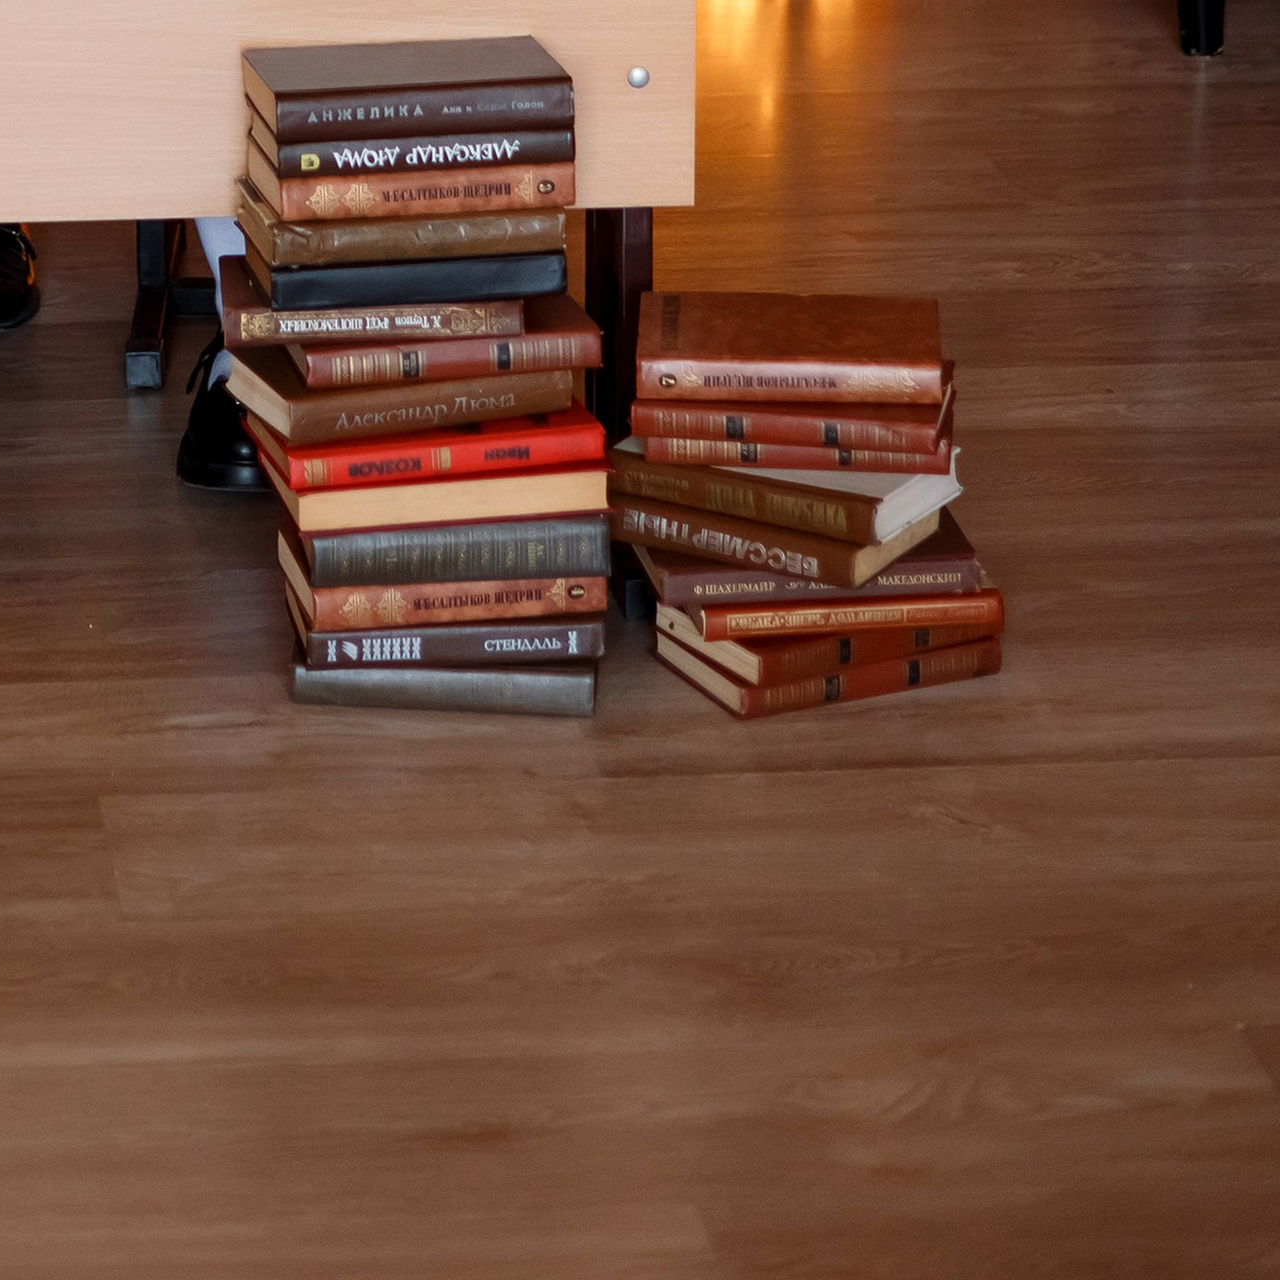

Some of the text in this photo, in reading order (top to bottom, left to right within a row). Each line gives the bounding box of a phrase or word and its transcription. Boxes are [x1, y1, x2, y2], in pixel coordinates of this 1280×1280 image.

[308, 104, 424, 124] АНЖЕЛИКА
[333, 139, 521, 170] АЛЕКСАНДР ДЮМА
[335, 393, 517, 430] Александр Дюма
[623, 507, 819, 579] БЕССМЕРТНЫЕ
[705, 581, 776, 595] ШАХЕРМАЙР
[877, 572, 962, 587] МАКЕДОНСКИЙ
[484, 636, 561, 653] СТЕНДАЛЬ
